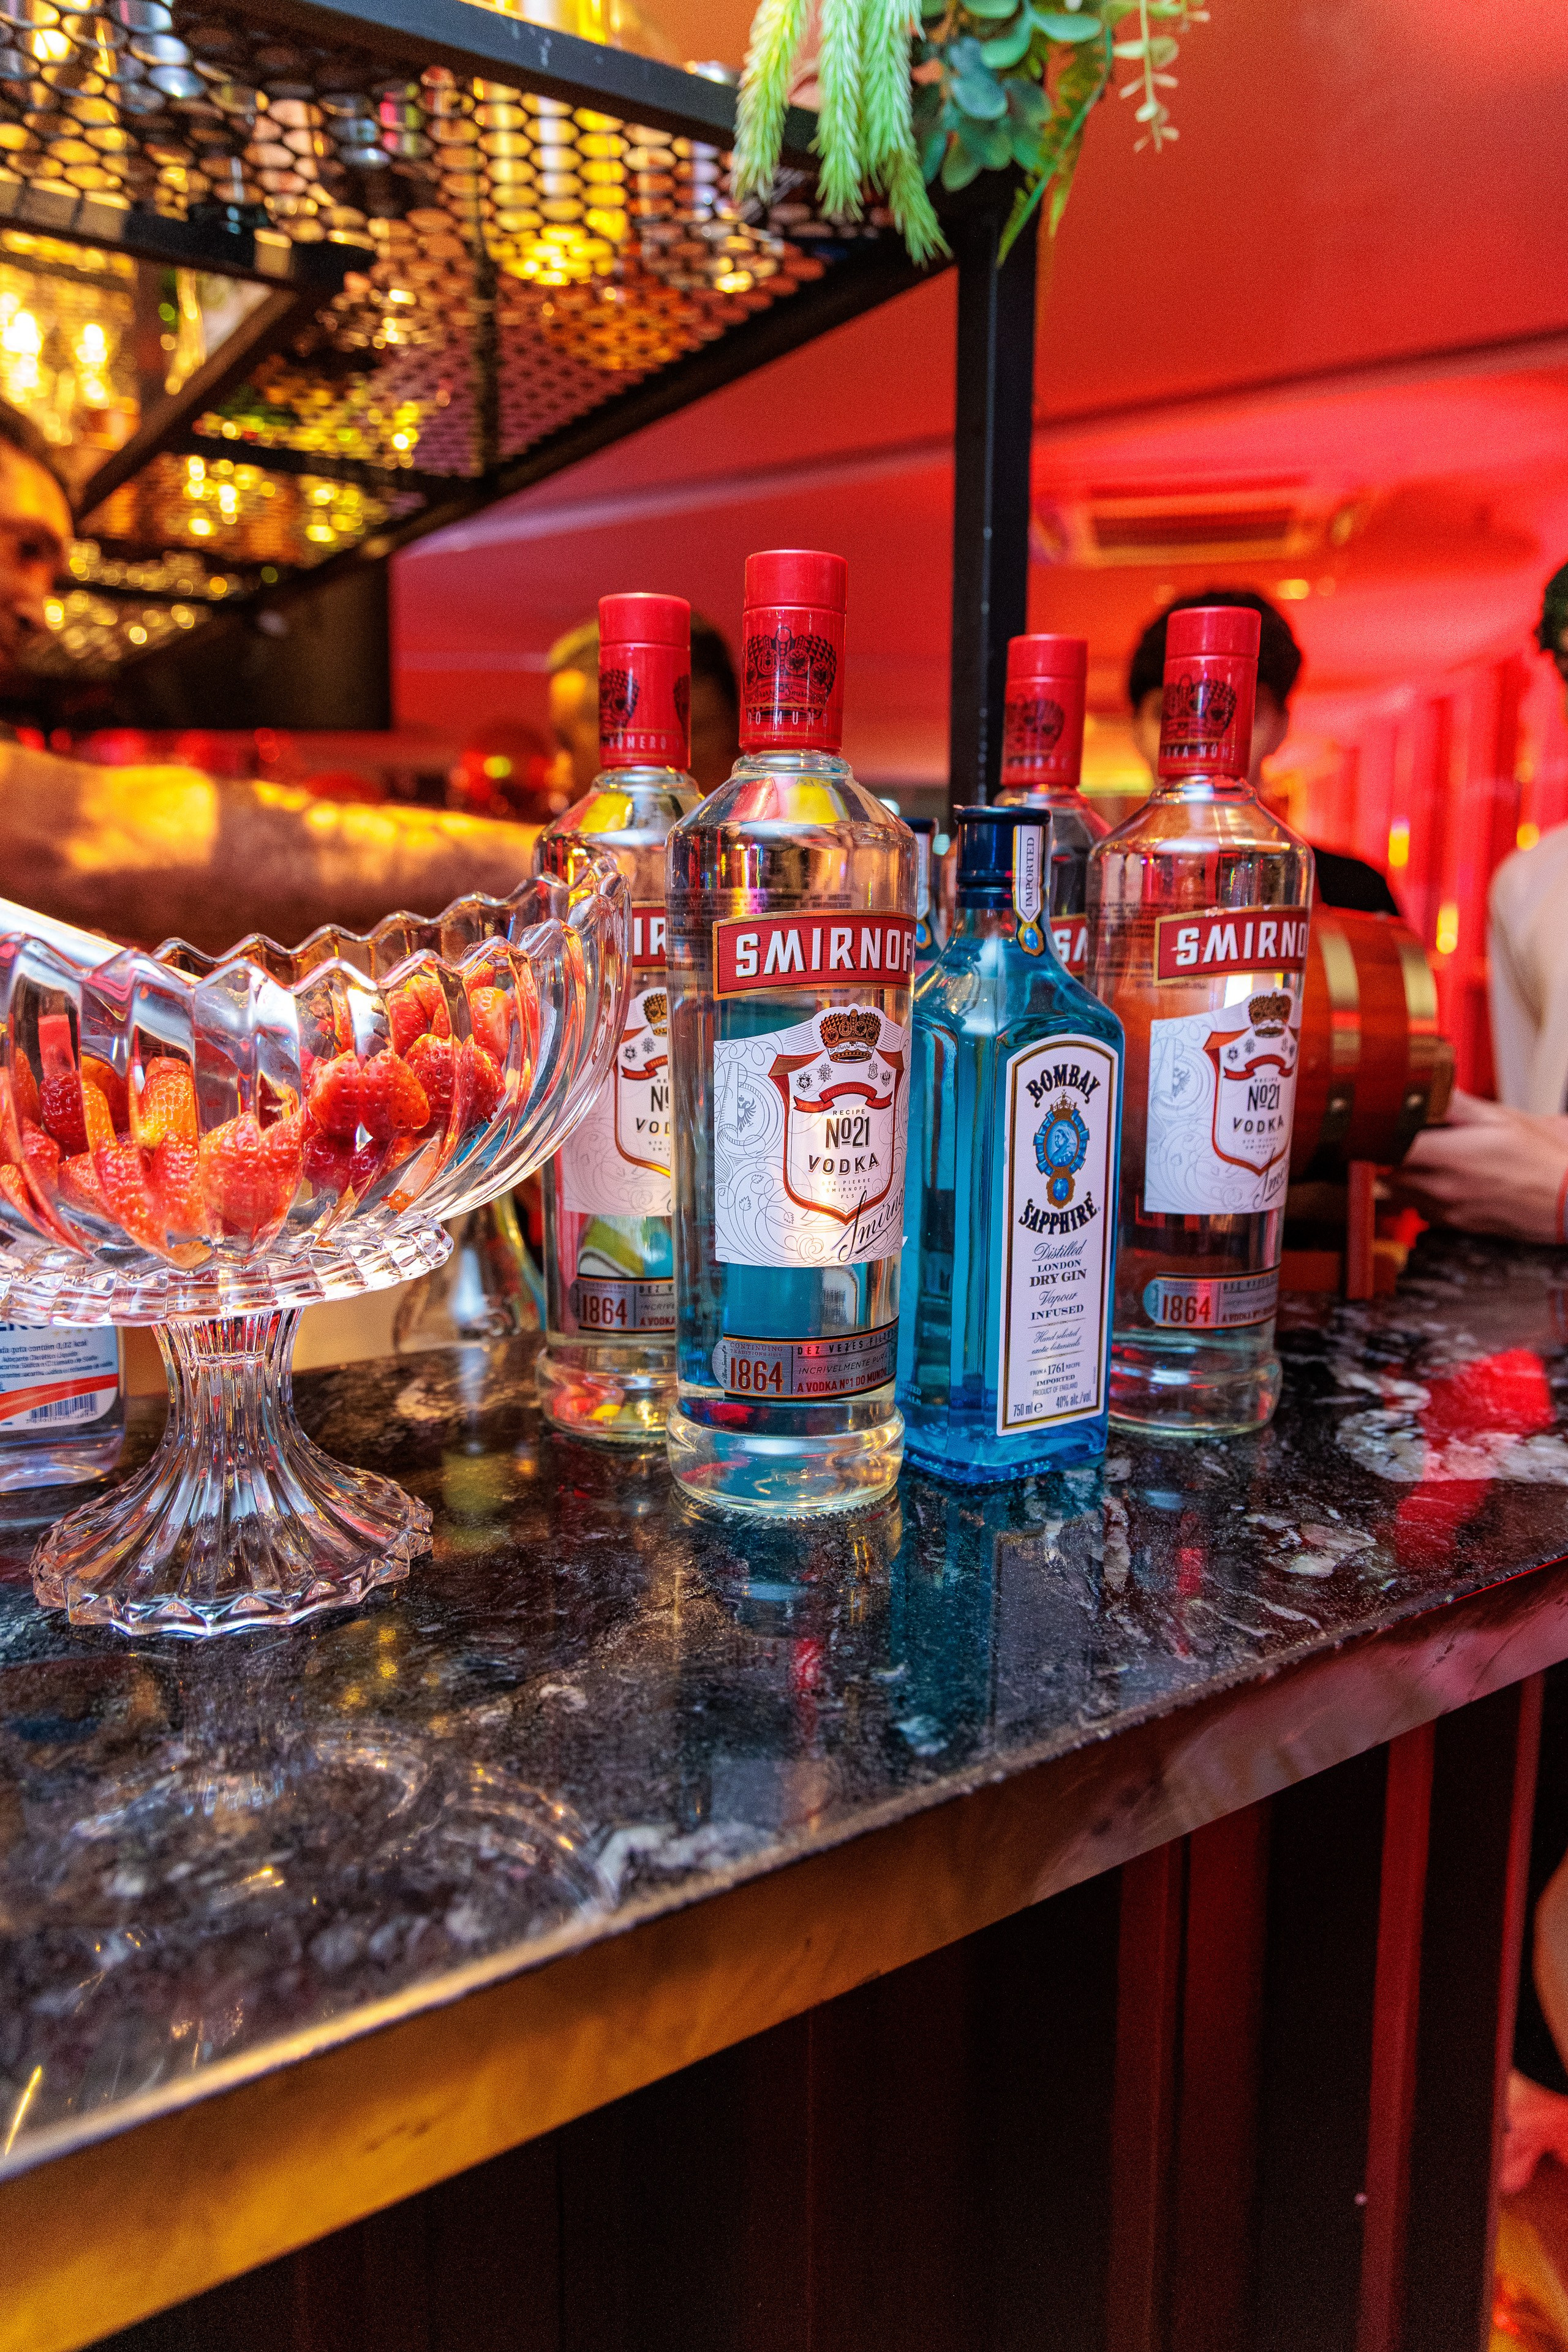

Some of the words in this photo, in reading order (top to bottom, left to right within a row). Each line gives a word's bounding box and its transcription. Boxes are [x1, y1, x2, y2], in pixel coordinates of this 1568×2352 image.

[1026, 836, 1035, 907] IMPORTED
[1025, 1063, 1101, 1109] BOMBAY
[1233, 1115, 1285, 1133] VODKA
[808, 1152, 880, 1176] VODKA
[1017, 1191, 1098, 1235] SAPPHIRE
[1031, 1239, 1087, 1262] Distilled
[1037, 1259, 1082, 1273] LONDON
[1029, 1273, 1060, 1287] DRY
[1061, 1268, 1087, 1283] GIN
[1039, 1289, 1079, 1308] Vapour
[582, 1294, 628, 1326] 1864
[1031, 1303, 1084, 1321] INFUSED
[1162, 1294, 1211, 1324] 1864
[1034, 1330, 1058, 1344] Hand
[1056, 1326, 1081, 1340] selected
[729, 1342, 783, 1352] CONTINUING
[797, 1346, 820, 1355] DEZ
[829, 1340, 863, 1353] VEZES
[1031, 1345, 1049, 1355] exotic
[1050, 1335, 1082, 1351] botanicals
[730, 1357, 784, 1393] 1864
[799, 1358, 870, 1375] INCRIVELMENTE
[1047, 1362, 1065, 1376] 1761
[797, 1382, 804, 1393] A
[806, 1379, 838, 1392] VODKA
[856, 1374, 865, 1386] DO
[1033, 1387, 1052, 1396] PRODUCT
[1059, 1381, 1078, 1391] ENGLAND
[1036, 1374, 1076, 1387] IMPORTED
[1013, 1404, 1024, 1417] 750
[1025, 1402, 1033, 1414] ml
[1055, 1395, 1069, 1409] 40%
